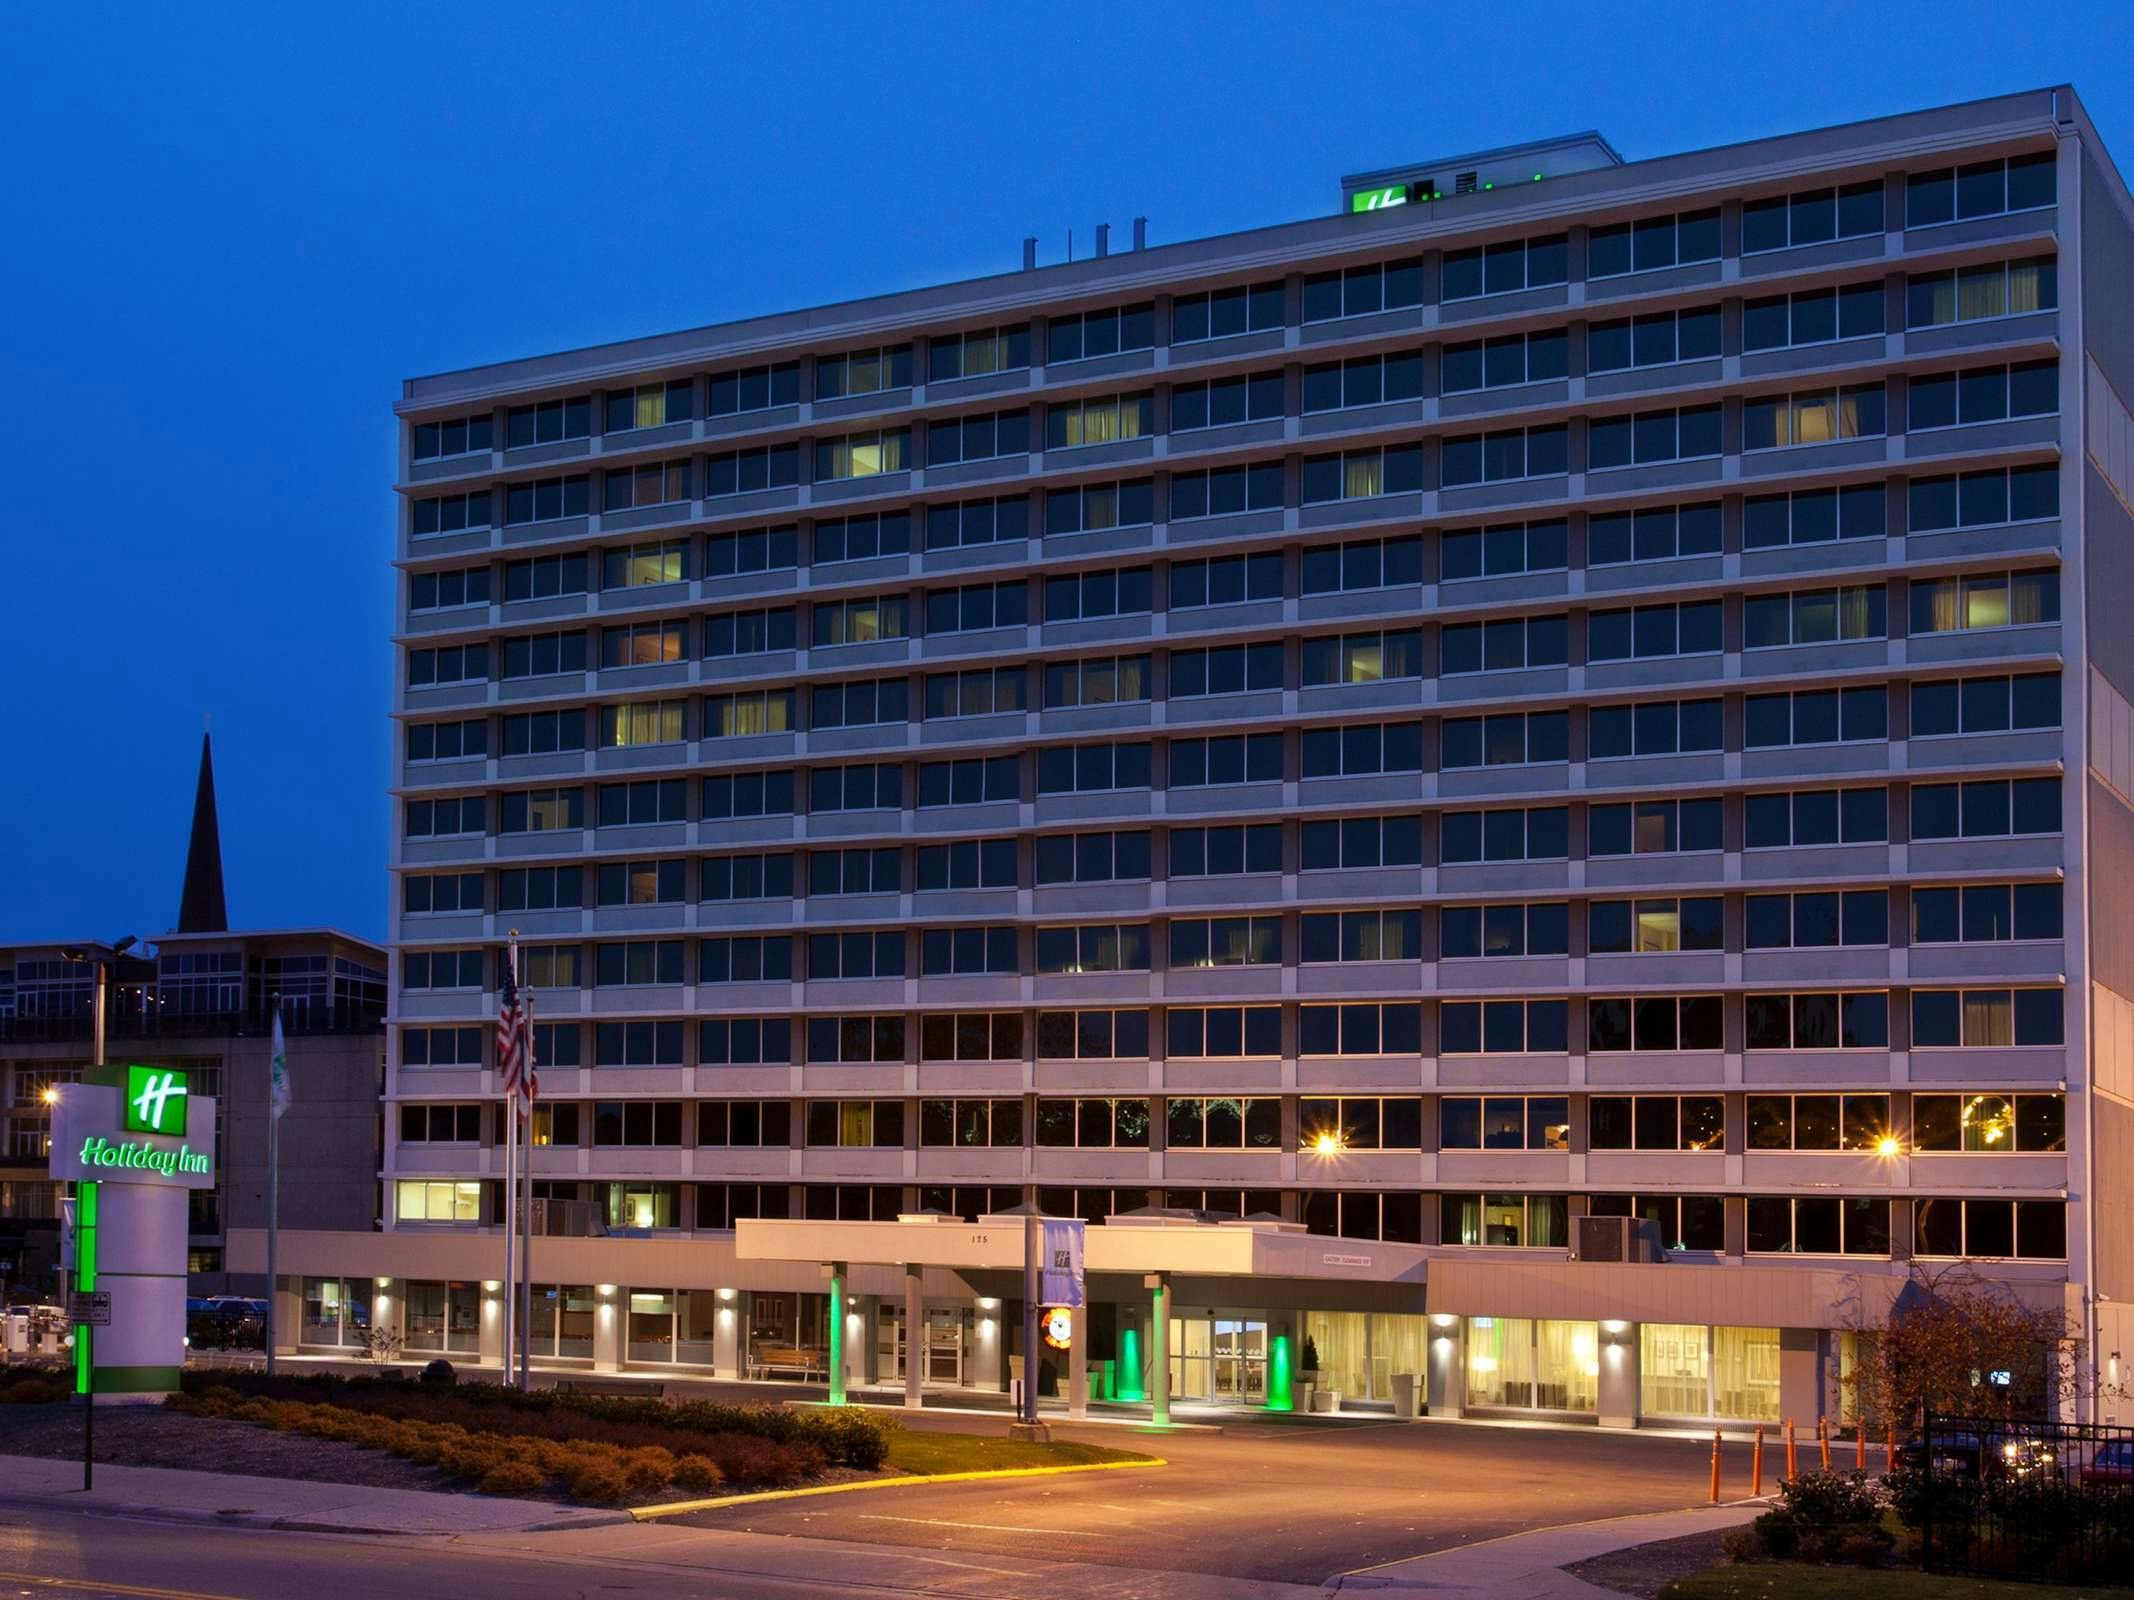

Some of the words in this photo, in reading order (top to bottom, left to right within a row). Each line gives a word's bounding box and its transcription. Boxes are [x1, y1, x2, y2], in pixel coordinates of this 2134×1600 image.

[80, 1137, 176, 1177] Holiday
[178, 1144, 209, 1174] Inn
[971, 1235, 988, 1244] 175
